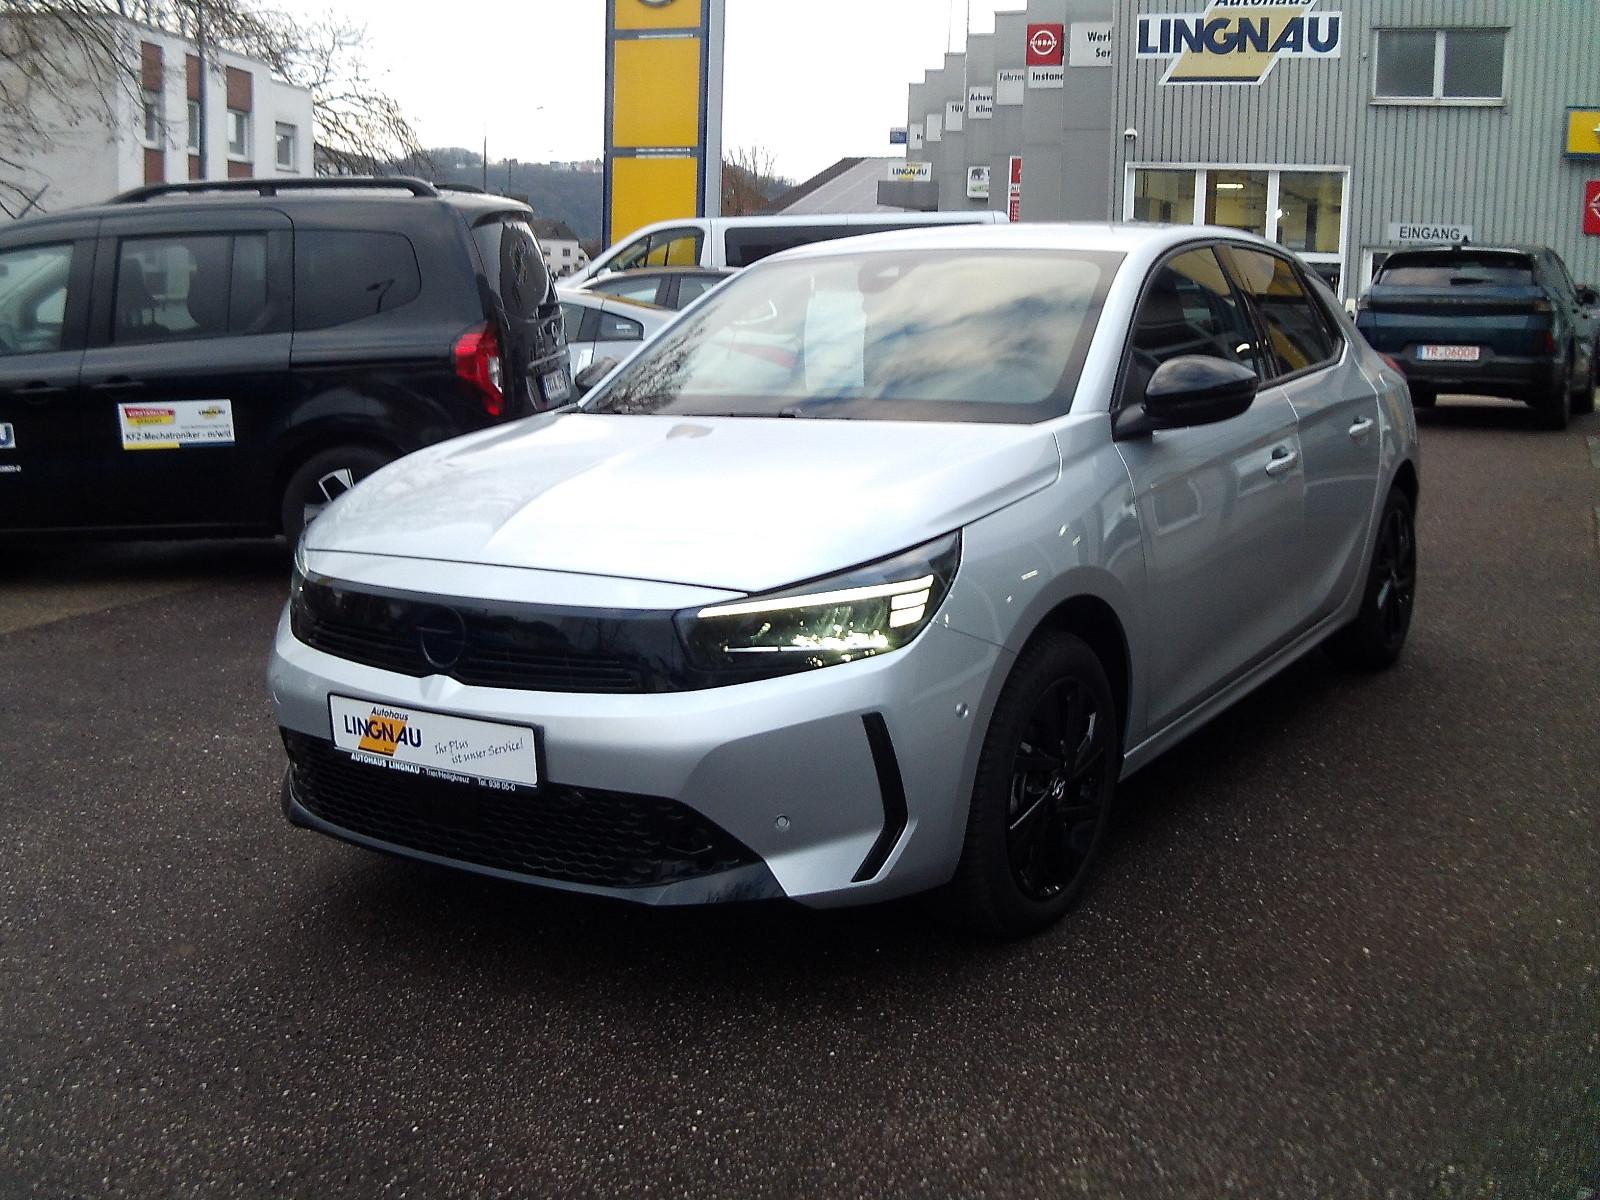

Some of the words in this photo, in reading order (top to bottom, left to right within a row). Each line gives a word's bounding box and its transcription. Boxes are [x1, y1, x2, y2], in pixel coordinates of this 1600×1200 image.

[1030, 39, 1057, 47] NISSAN
[1137, 16, 1341, 55] LINGNAU
[892, 167, 927, 176] LINGNAU
[1399, 226, 1460, 240] EINGANG
[371, 706, 409, 721] Autohaus
[344, 714, 422, 748] LINGNAU
[434, 742, 447, 755] Ihr
[448, 740, 469, 755] Plus
[351, 753, 387, 768] AUTOHAUS
[388, 760, 420, 774] LINGNAU
[452, 754, 463, 767] ist
[464, 751, 486, 765] unser
